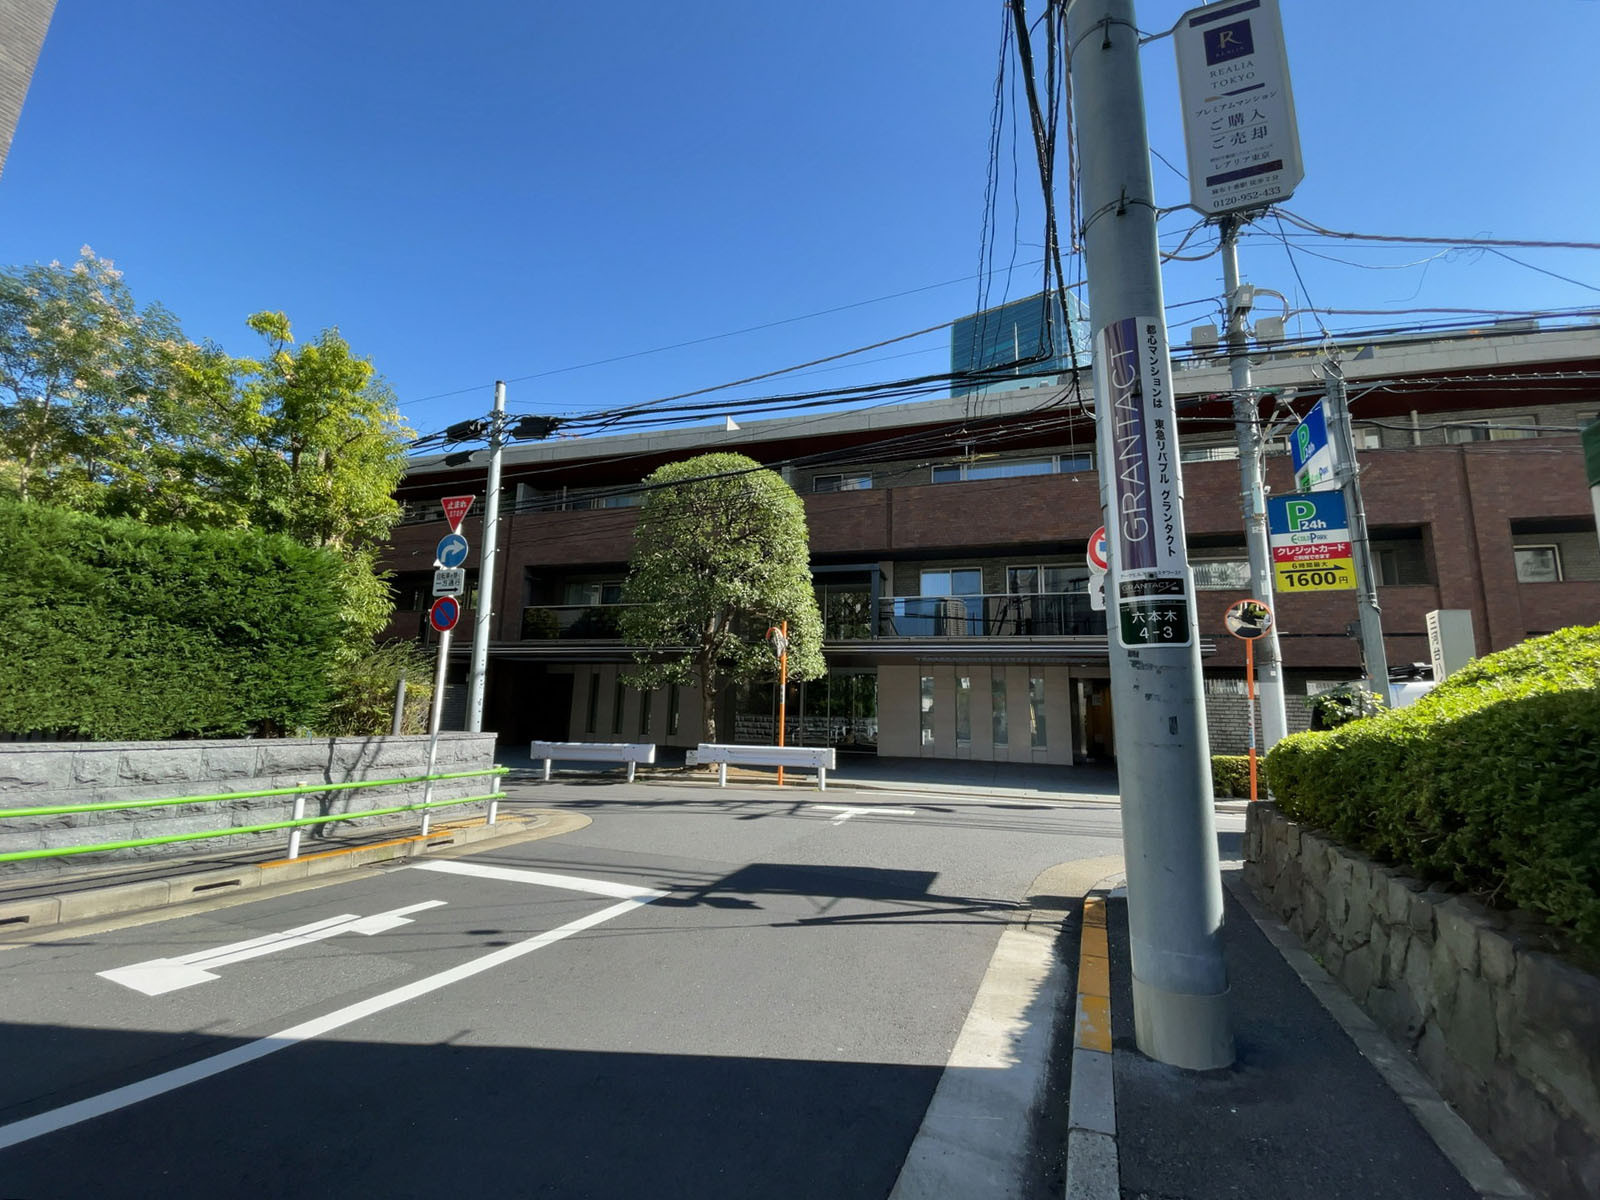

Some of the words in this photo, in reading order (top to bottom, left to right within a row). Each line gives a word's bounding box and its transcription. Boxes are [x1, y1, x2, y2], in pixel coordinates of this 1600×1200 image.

[1209, 60, 1254, 78] REALIA
[1211, 71, 1255, 89] TOKYO
[1195, 91, 1277, 117] プレミアムマンション
[1210, 108, 1265, 131] ご購入
[1212, 125, 1268, 149] ご売却
[1215, 151, 1270, 170] レアリア東京
[1213, 186, 1281, 208] 0120-952-433
[1146, 324, 1163, 409] 都心マンションは
[1110, 348, 1149, 542] GRANTACT
[1154, 419, 1169, 484] 東急リバブル
[1161, 490, 1176, 557] グランタクト
[1285, 500, 1317, 532] P
[1301, 519, 1327, 530] 24h
[1277, 543, 1346, 556] クレジットカード
[1121, 581, 1170, 591] GRANTACT
[1131, 609, 1178, 624] 六本木
[1139, 626, 1173, 639] 4-3
